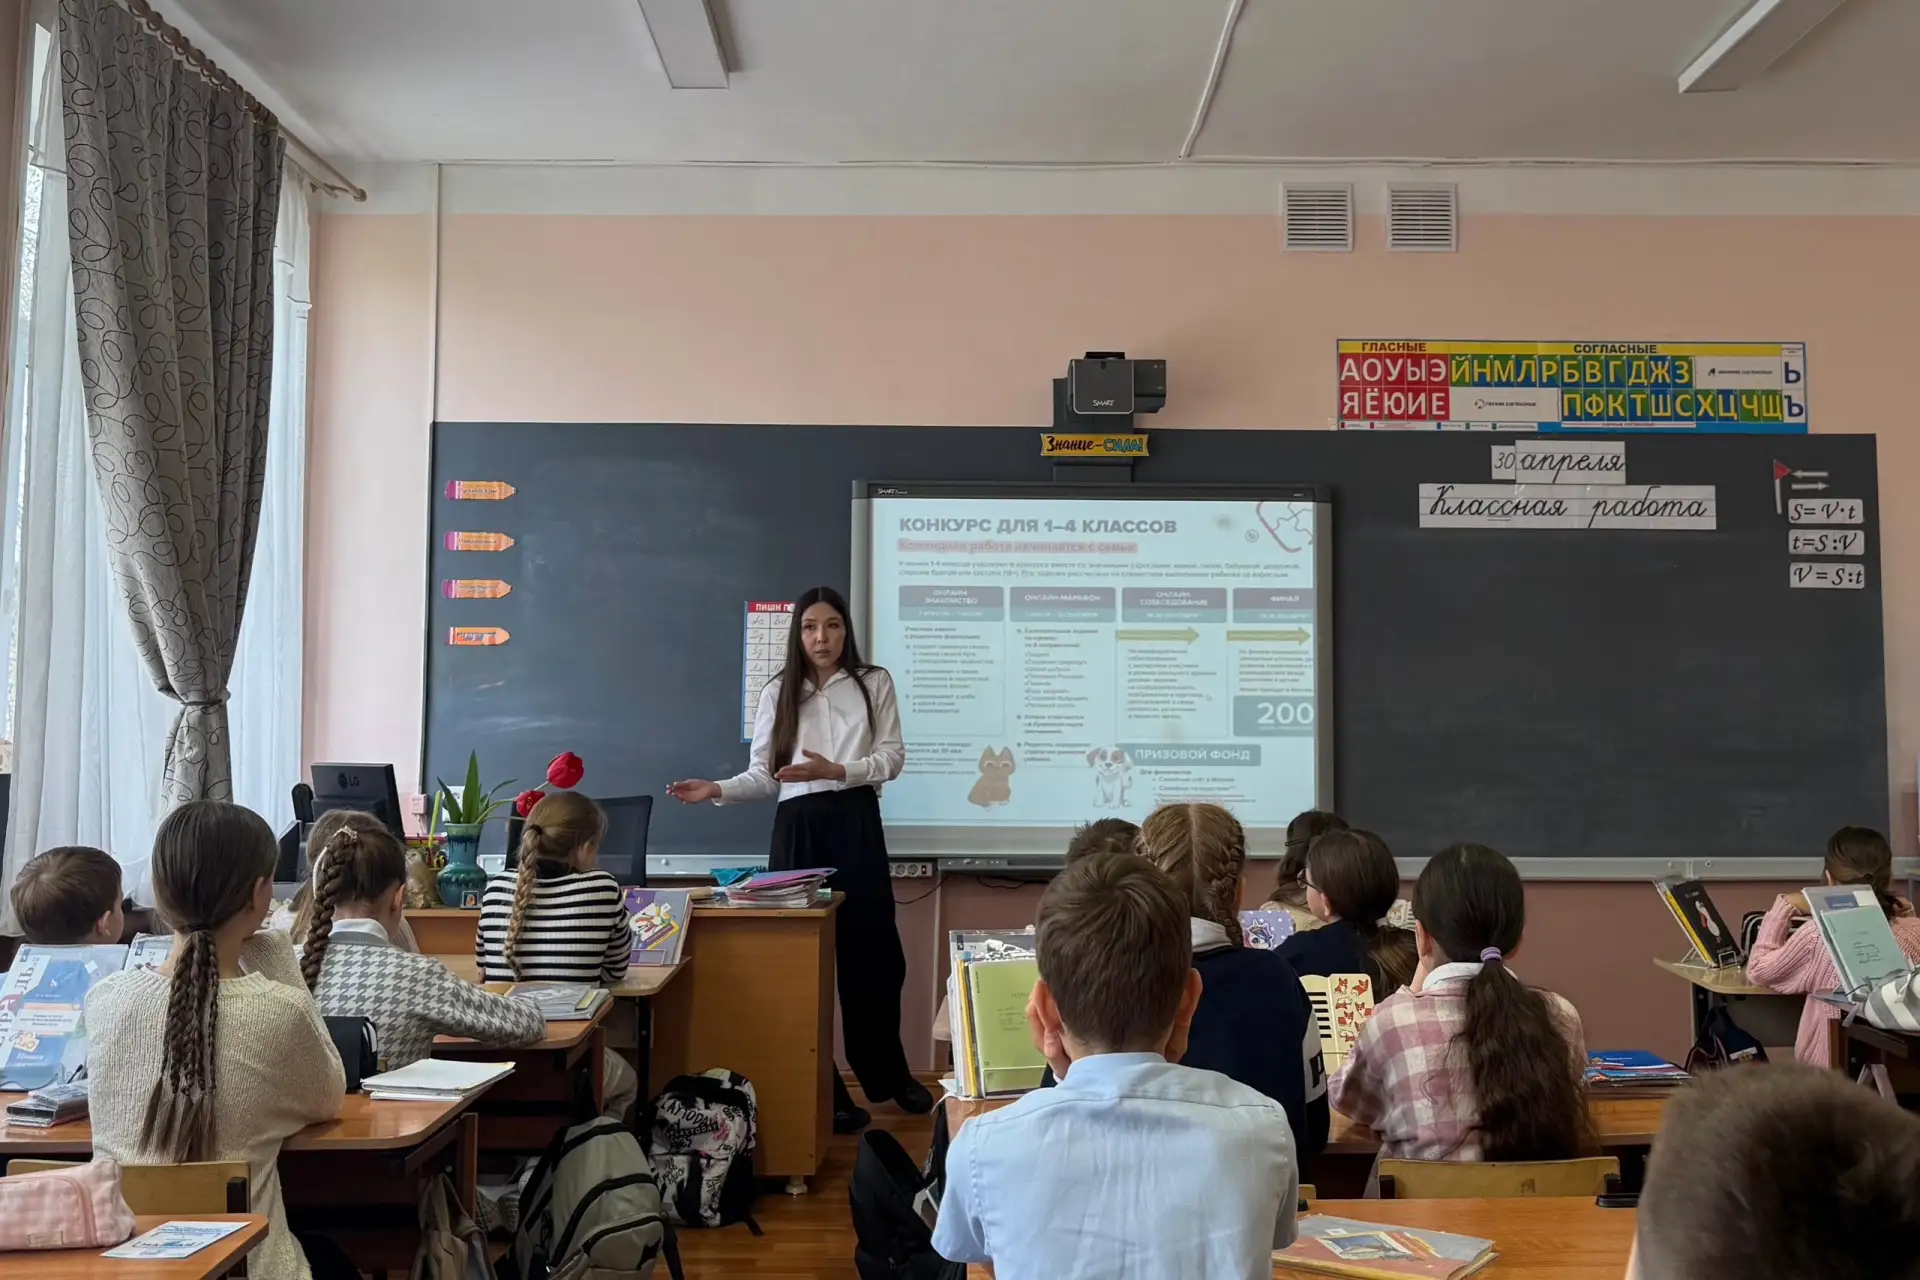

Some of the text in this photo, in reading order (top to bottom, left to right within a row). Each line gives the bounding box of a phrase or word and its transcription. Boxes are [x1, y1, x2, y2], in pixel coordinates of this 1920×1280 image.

[1361, 342, 1426, 352] ГЛАСНЫЕ
[1573, 344, 1657, 354] СОГЛАСНЫЕ
[1092, 399, 1115, 407] SMART
[1046, 435, 1094, 452] Знание
[1494, 452, 1625, 484] 30 апреля
[1429, 484, 1708, 529] Классная работа
[899, 518, 992, 533] КОНКУРС
[996, 519, 1039, 534] ДЛЯ
[1082, 519, 1178, 534] КЛАССОВ
[970, 540, 1012, 555] работа
[755, 603, 782, 612] ПИШИ
[1256, 702, 1315, 725] 200
[1134, 748, 1250, 761] ПРИЗОВОЙ ФОНД
[349, 776, 360, 787] LG
